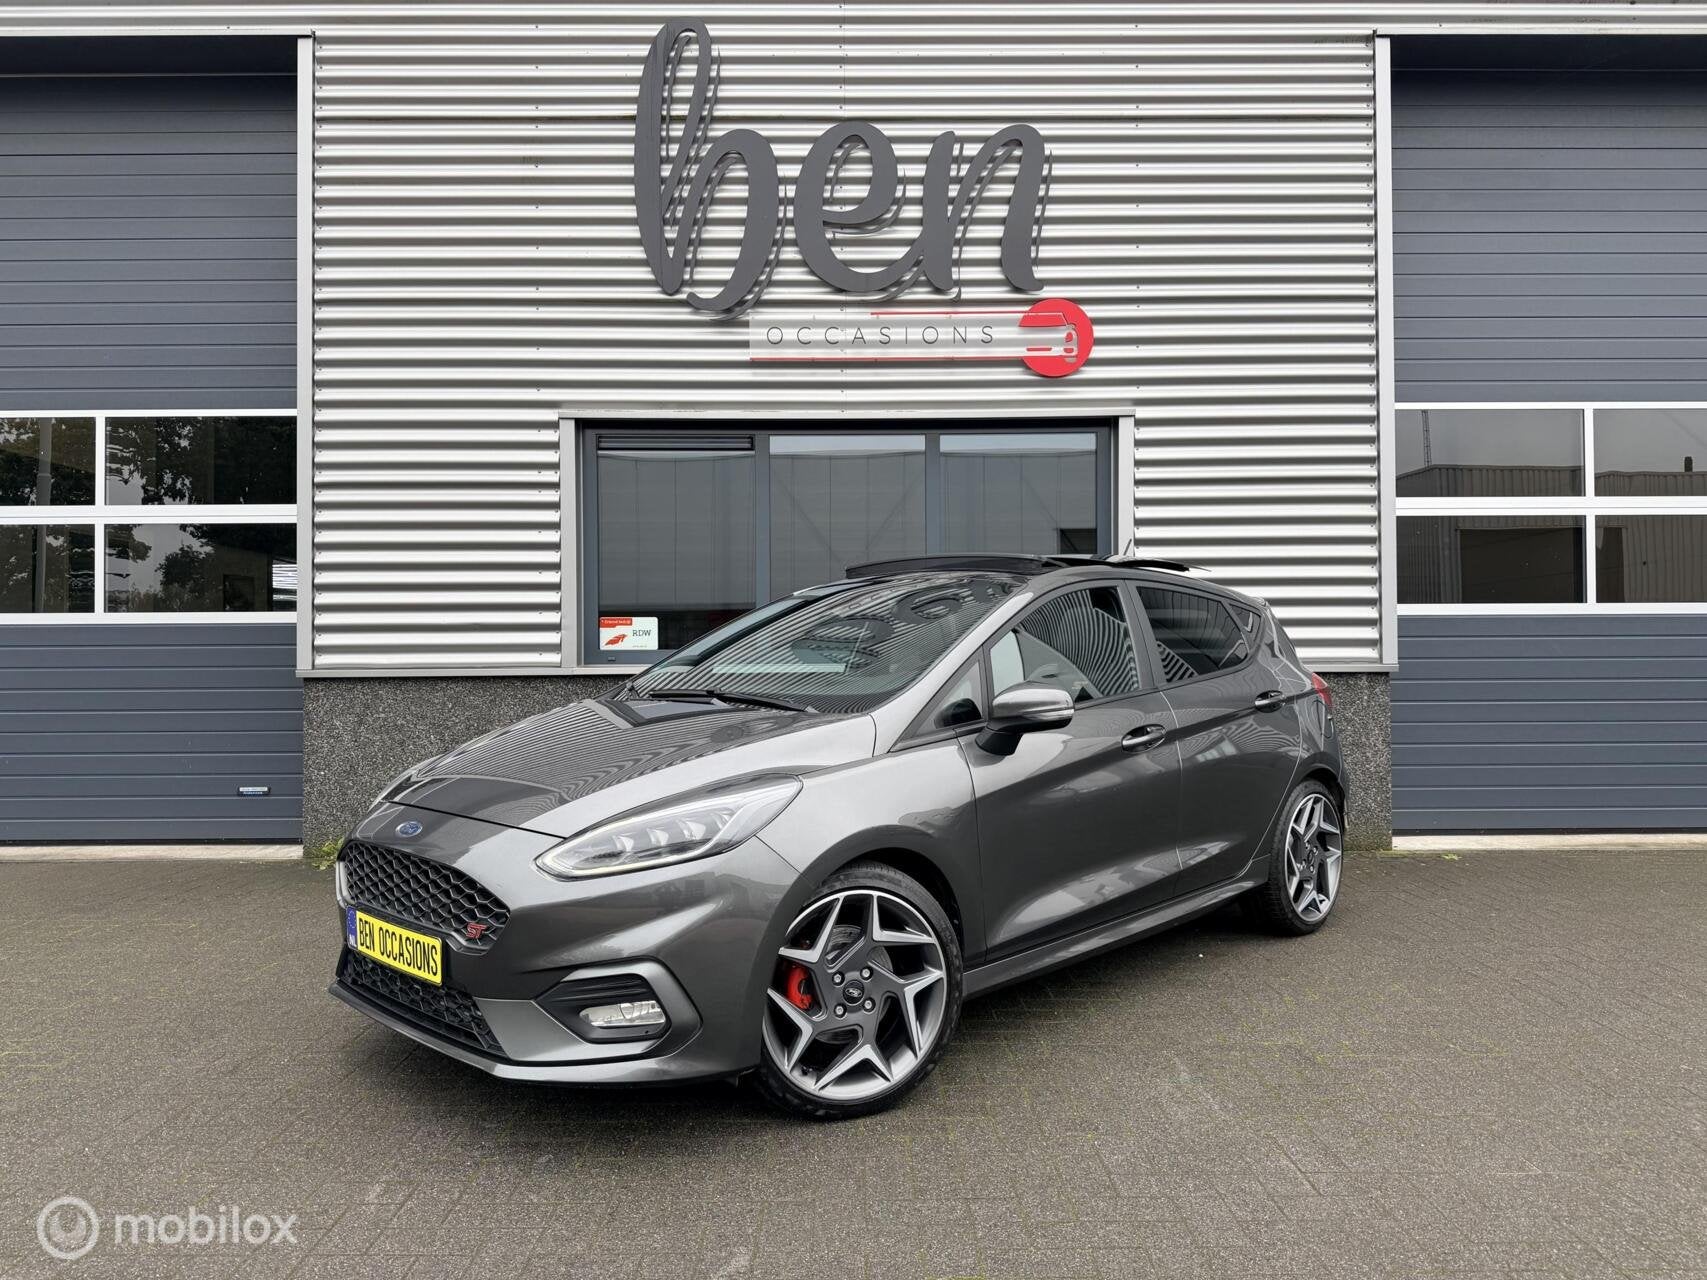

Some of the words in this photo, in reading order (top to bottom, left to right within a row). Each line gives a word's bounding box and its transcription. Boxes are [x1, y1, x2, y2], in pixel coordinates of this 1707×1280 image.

[633, 18, 1045, 311] ben
[766, 325, 994, 345] OCCASIONS
[632, 629, 652, 637] RDW
[465, 922, 487, 939] ST
[358, 917, 376, 953] BEN
[378, 926, 438, 977] OCCASIONS
